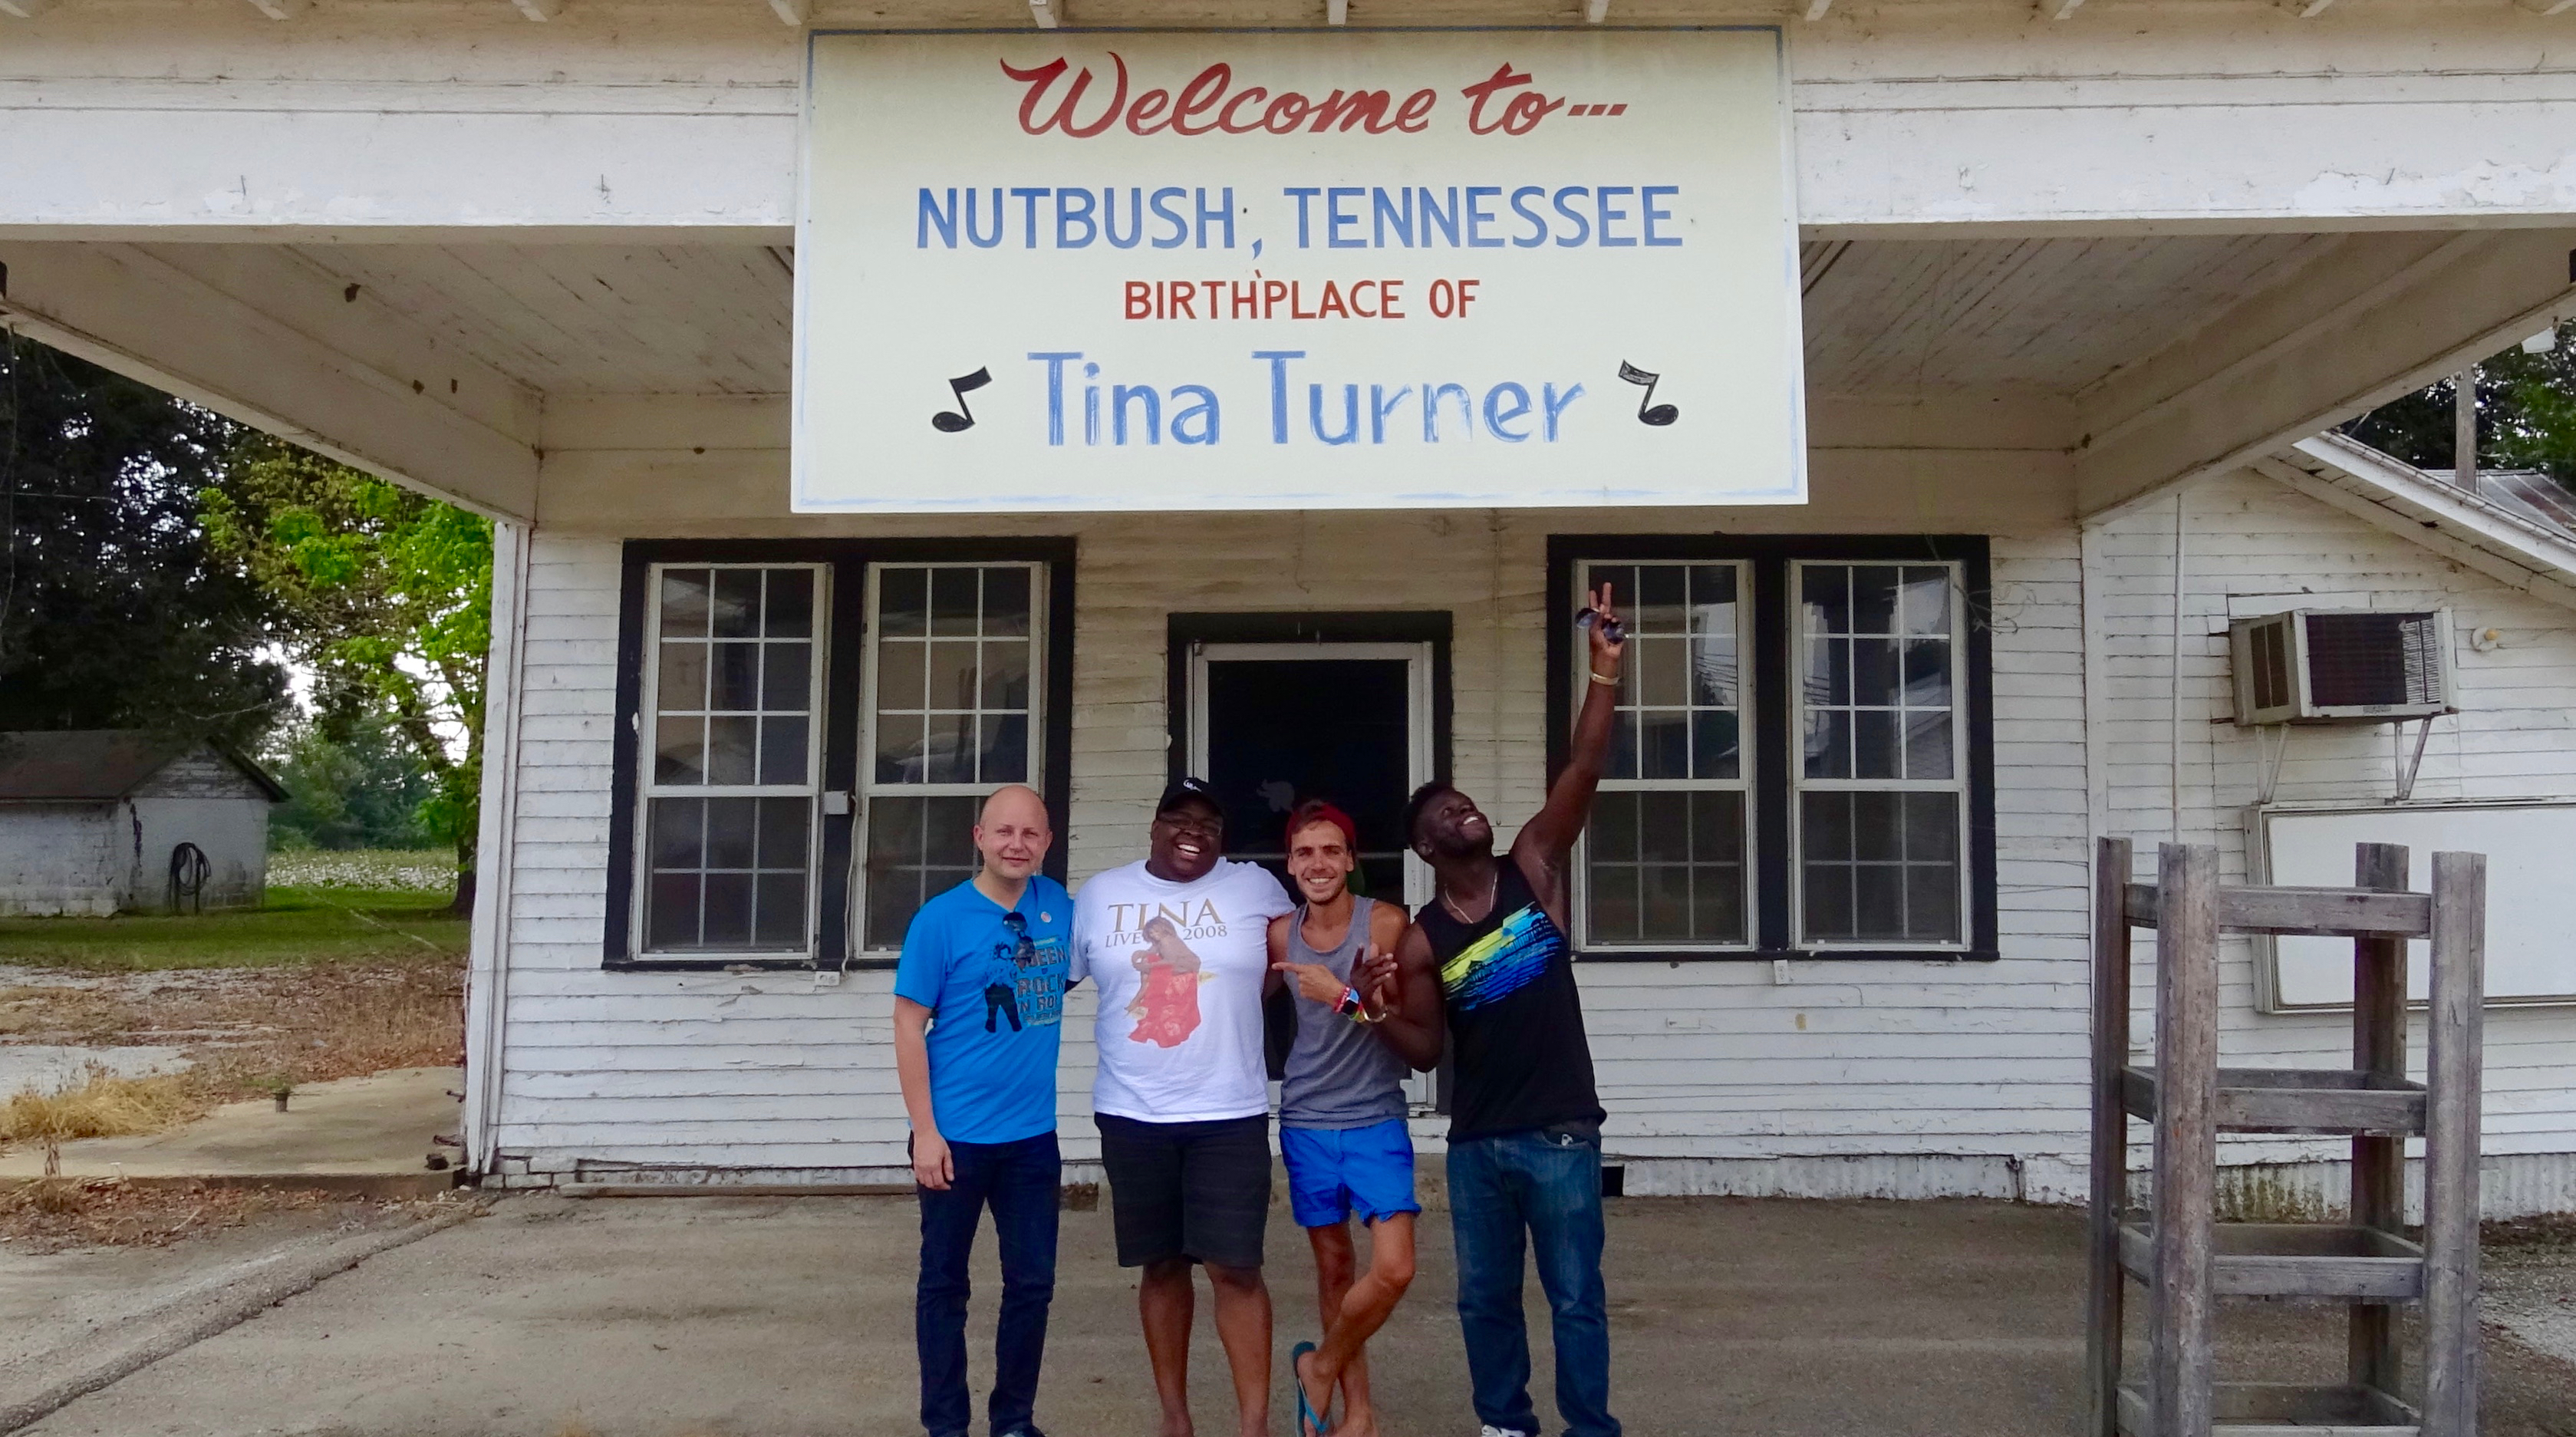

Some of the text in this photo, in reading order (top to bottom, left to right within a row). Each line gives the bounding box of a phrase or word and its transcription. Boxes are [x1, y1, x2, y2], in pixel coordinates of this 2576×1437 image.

[1000, 51, 1437, 137] Welcome
[917, 186, 1683, 261] NUTBUSH, TENNESSEE
[1125, 279, 1481, 321] BIRTHPLACE OF
[1026, 350, 1586, 447] Tina Turner
[1105, 924, 1228, 948] LIVE 2008
[1107, 898, 1226, 934] TINA
[1016, 944, 1067, 971] UEEN
